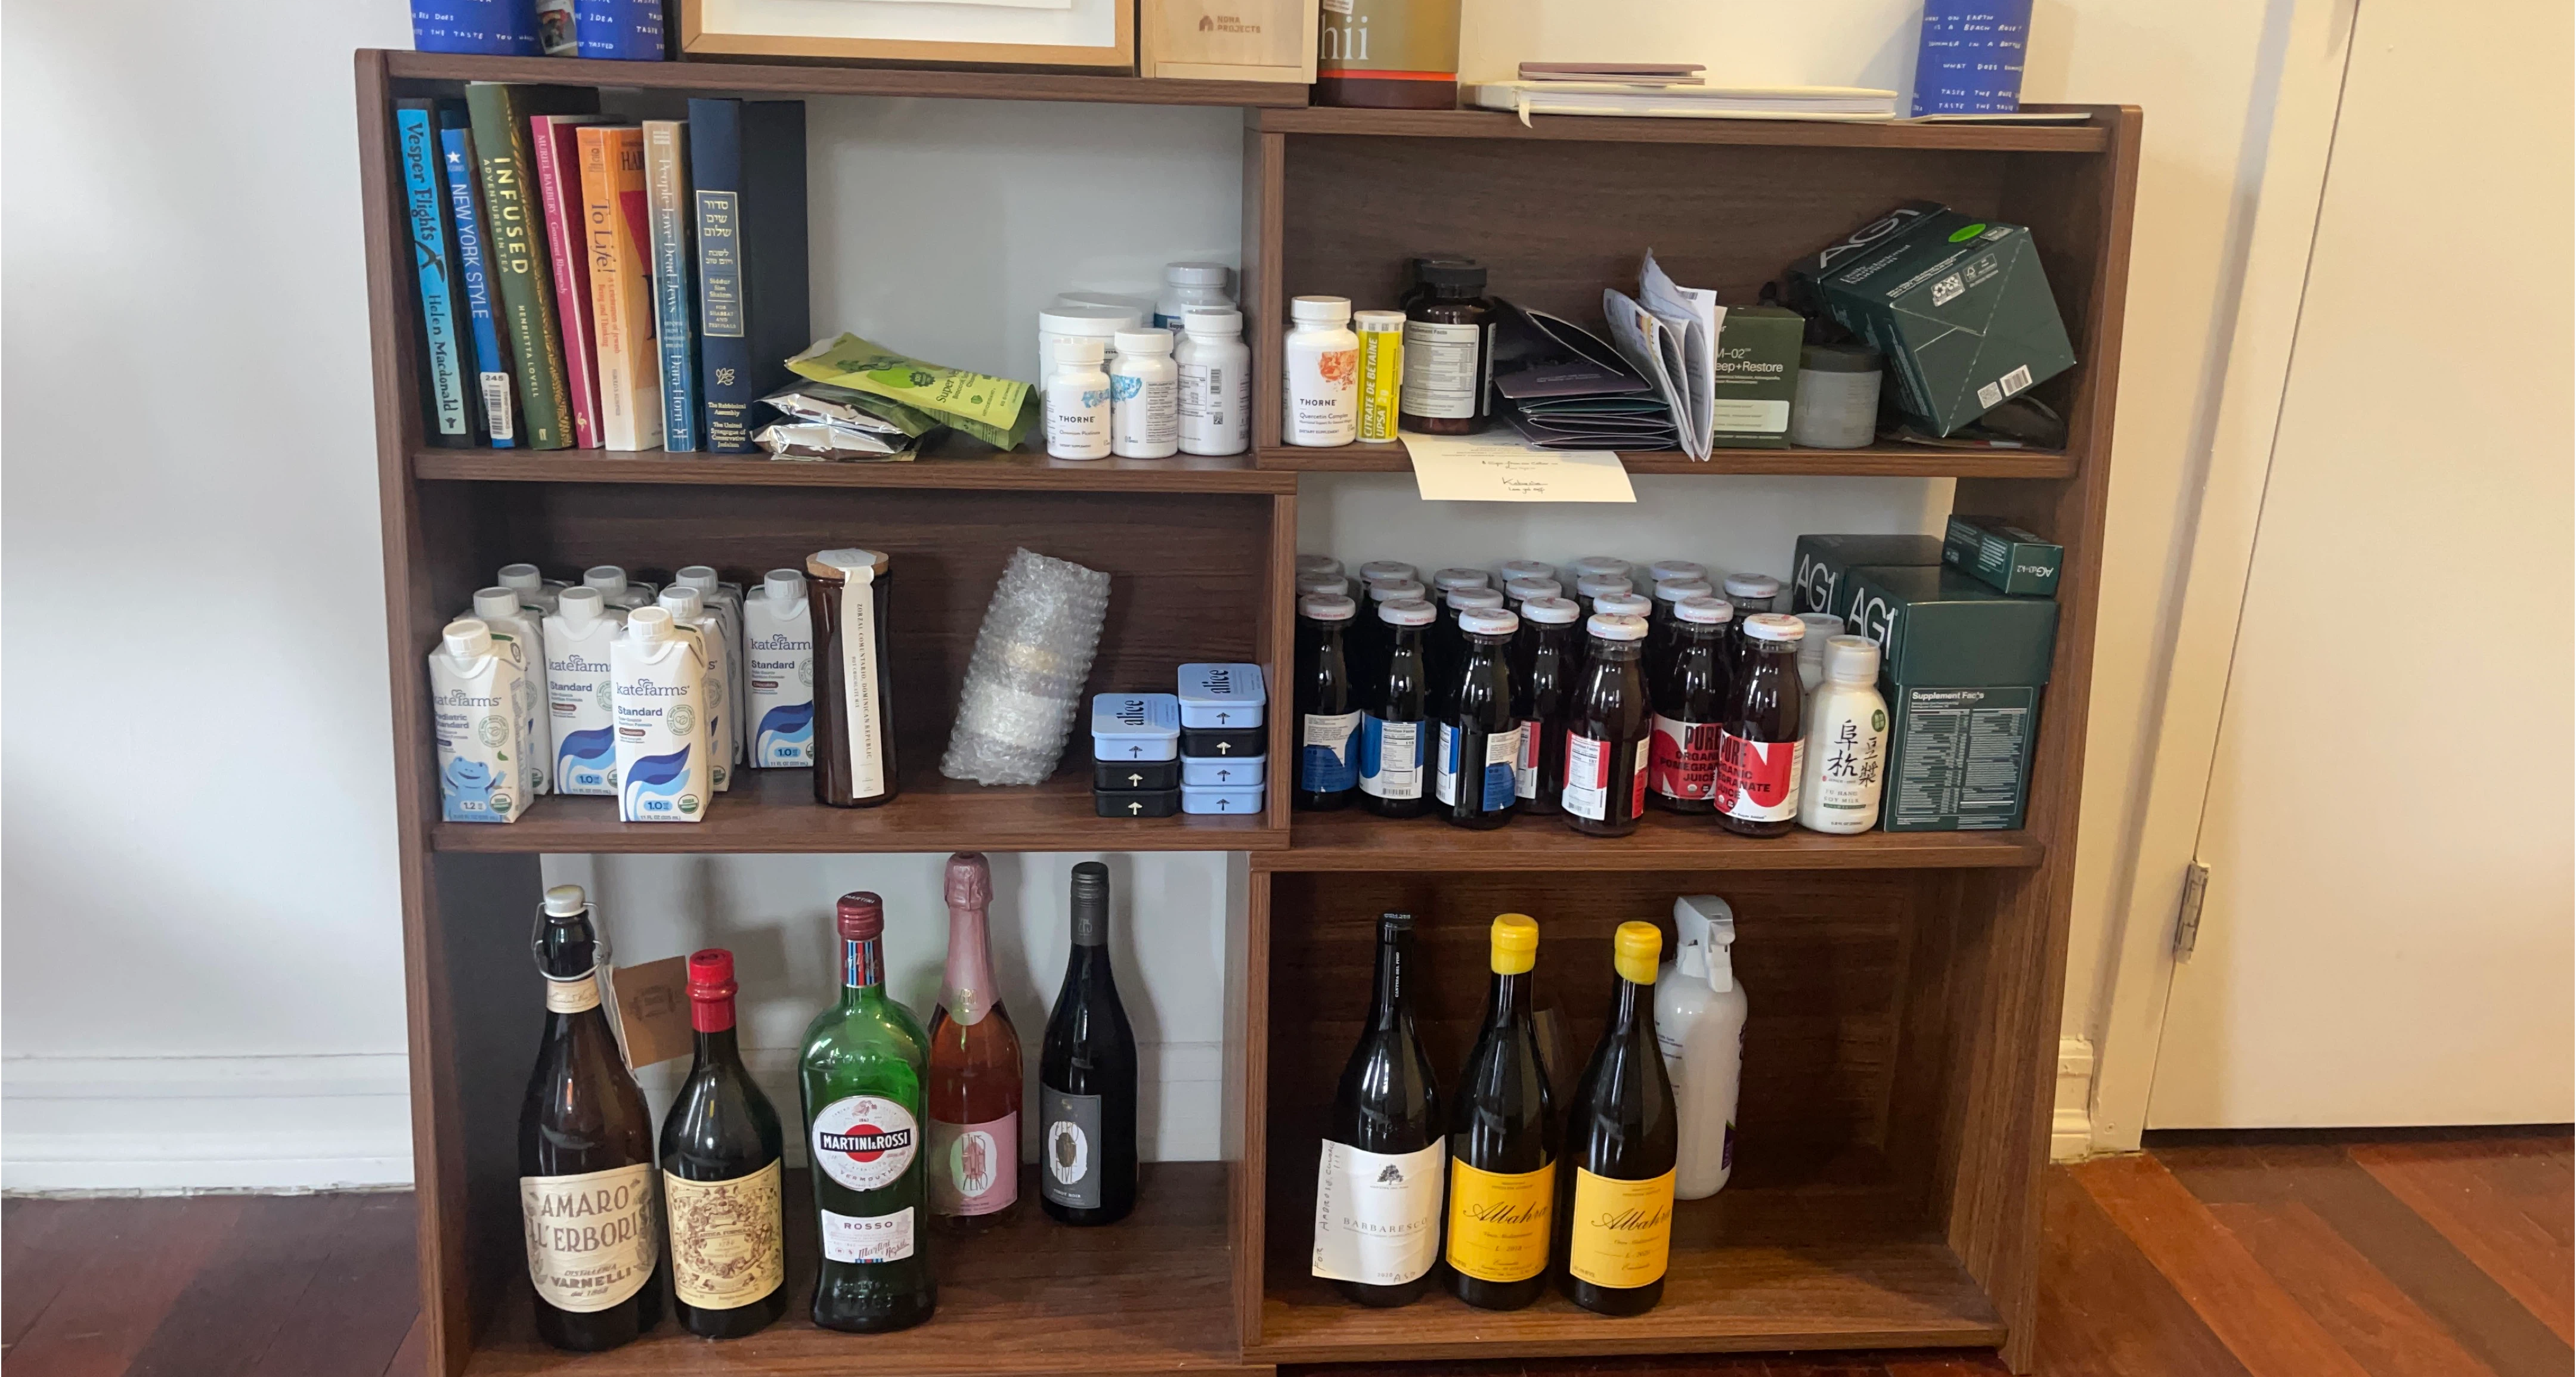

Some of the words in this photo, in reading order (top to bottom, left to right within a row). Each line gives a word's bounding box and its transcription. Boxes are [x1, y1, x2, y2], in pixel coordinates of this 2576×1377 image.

[590, 13, 613, 23] IDEA
[1217, 24, 1262, 34] PROJECTS
[453, 31, 484, 40] TASTE
[407, 123, 425, 183] Vesper
[537, 135, 550, 172] MURIEL
[544, 173, 557, 215] BARBERY
[656, 159, 673, 204] People
[451, 184, 473, 220] NEW
[484, 159, 502, 234] ADVENTURES
[704, 200, 729, 210] סדור
[410, 187, 438, 241] Flights
[494, 157, 528, 274] INFUSED
[592, 199, 611, 224] To
[661, 208, 675, 240] Love
[706, 215, 727, 224] שים
[497, 237, 506, 249] IN
[550, 221, 562, 256] Gourmet
[704, 224, 732, 237] שלום
[1820, 209, 1921, 269] AG1
[460, 225, 480, 266] YORK
[590, 230, 616, 274] Life!
[500, 253, 508, 273] TEA
[663, 243, 678, 278] Dead
[555, 258, 568, 294] Rhapsody
[465, 272, 489, 318] STYLE
[597, 284, 606, 302] Being
[666, 281, 679, 313] Jews
[428, 294, 445, 335] Helen
[599, 318, 609, 348] Thinking
[614, 332, 622, 354] Jewish
[518, 305, 533, 359] HENRIETTA
[527, 361, 539, 398] LOVELL
[1366, 338, 1378, 380] BÉTAÏNE
[433, 341, 459, 412] Macdonald
[671, 355, 683, 386] Dara
[936, 379, 955, 403] Super
[1299, 398, 1336, 407] THORNE
[1366, 383, 1376, 395] DE
[672, 390, 685, 421] Horn
[1059, 415, 1095, 423] THORNE
[1363, 398, 1374, 437] CITRATE
[1376, 410, 1386, 437] UPSA
[1794, 553, 1836, 616] AG1
[1849, 587, 1896, 660] AG1
[751, 660, 795, 669] Standard
[550, 681, 593, 691] Standard
[1202, 669, 1231, 694] alice
[862, 683, 870, 723] DOMINICAN
[1912, 691, 1961, 701] Supplement
[618, 706, 663, 717] Standard
[1116, 700, 1144, 726] alice
[864, 725, 872, 759] REPUBLIC
[1676, 750, 1719, 761] ORGANI
[1722, 733, 1748, 768] PURE
[1826, 719, 1859, 778] 阜杭
[580, 775, 593, 784] 1.0
[648, 801, 662, 810] 1.0
[844, 895, 875, 904] MARTINI
[823, 1131, 908, 1150] MARTINI&ROSSI
[840, 1168, 894, 1181] VERMOUTH
[541, 1185, 630, 1218] AMARO
[844, 1221, 893, 1230] ROSSO
[1343, 1217, 1428, 1233] BARBARESCO
[1314, 1247, 1326, 1271] FOR
[550, 1267, 632, 1288] VARNELLI
